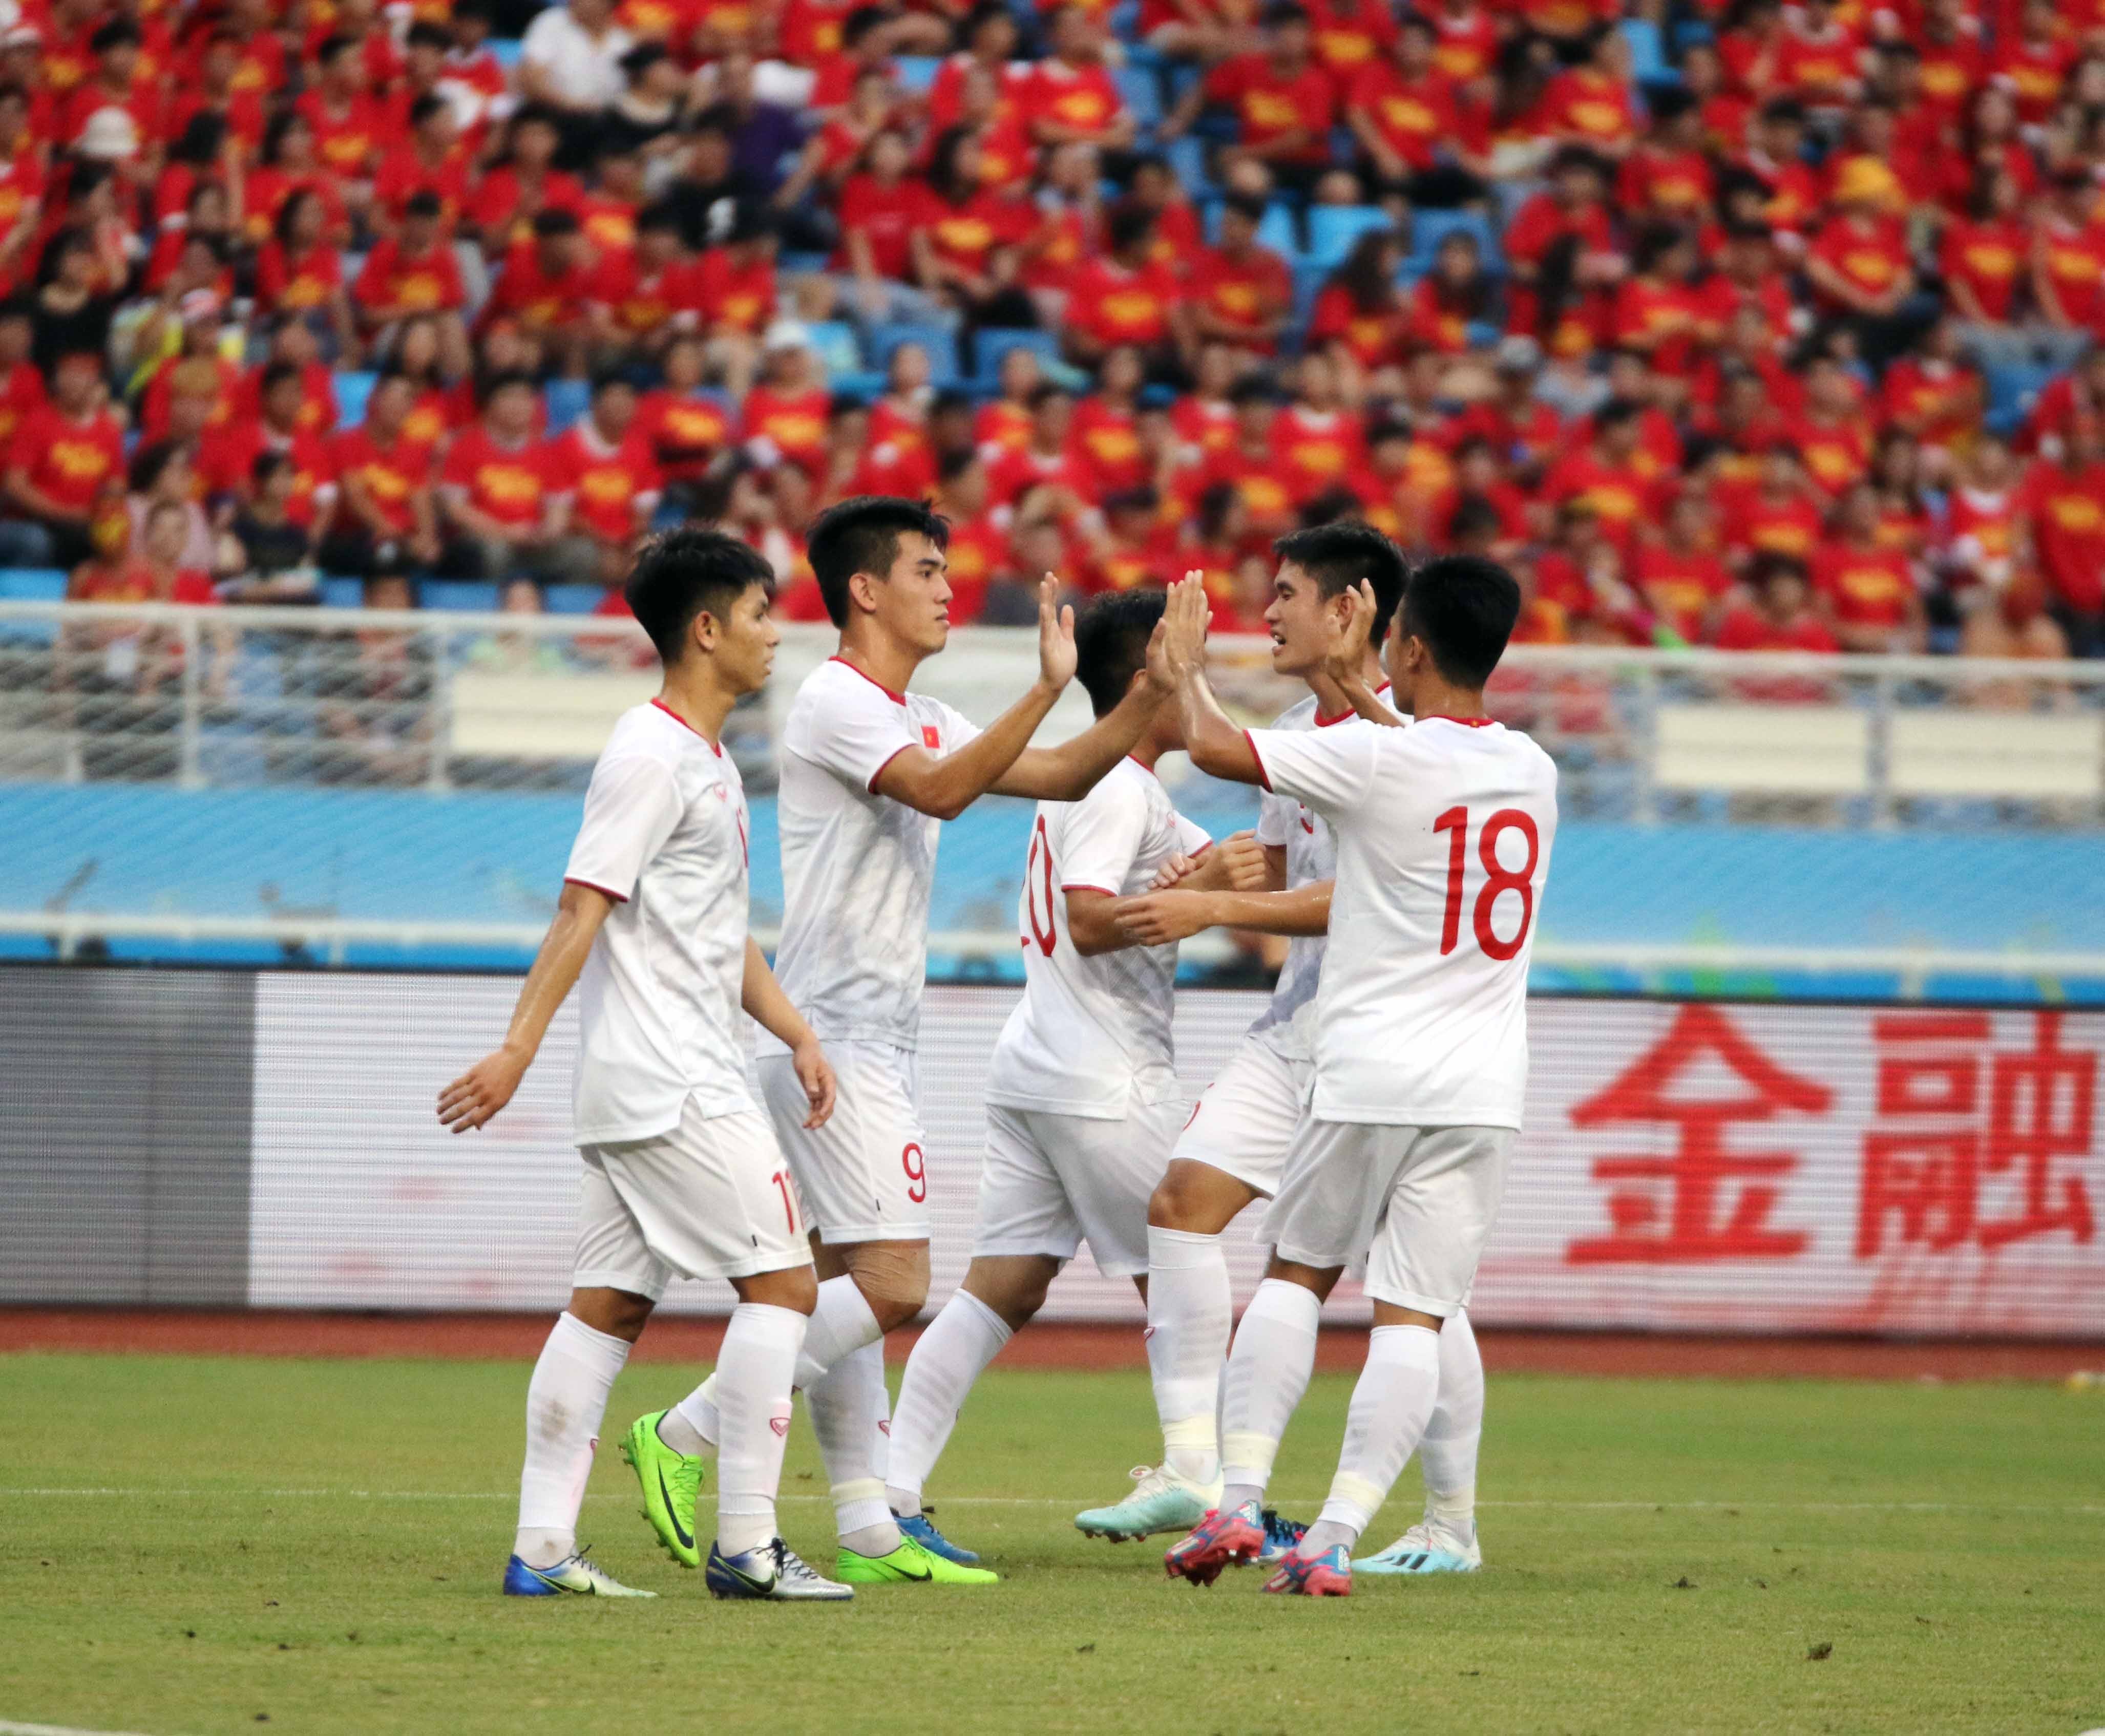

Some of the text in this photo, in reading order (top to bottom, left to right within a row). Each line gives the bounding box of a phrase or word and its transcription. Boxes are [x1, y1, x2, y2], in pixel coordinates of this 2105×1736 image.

[1021, 813, 1056, 957] 0
[1434, 806, 1539, 961] 18
[902, 1142, 926, 1203] 9
[1564, 1003, 2096, 1263] 金融
